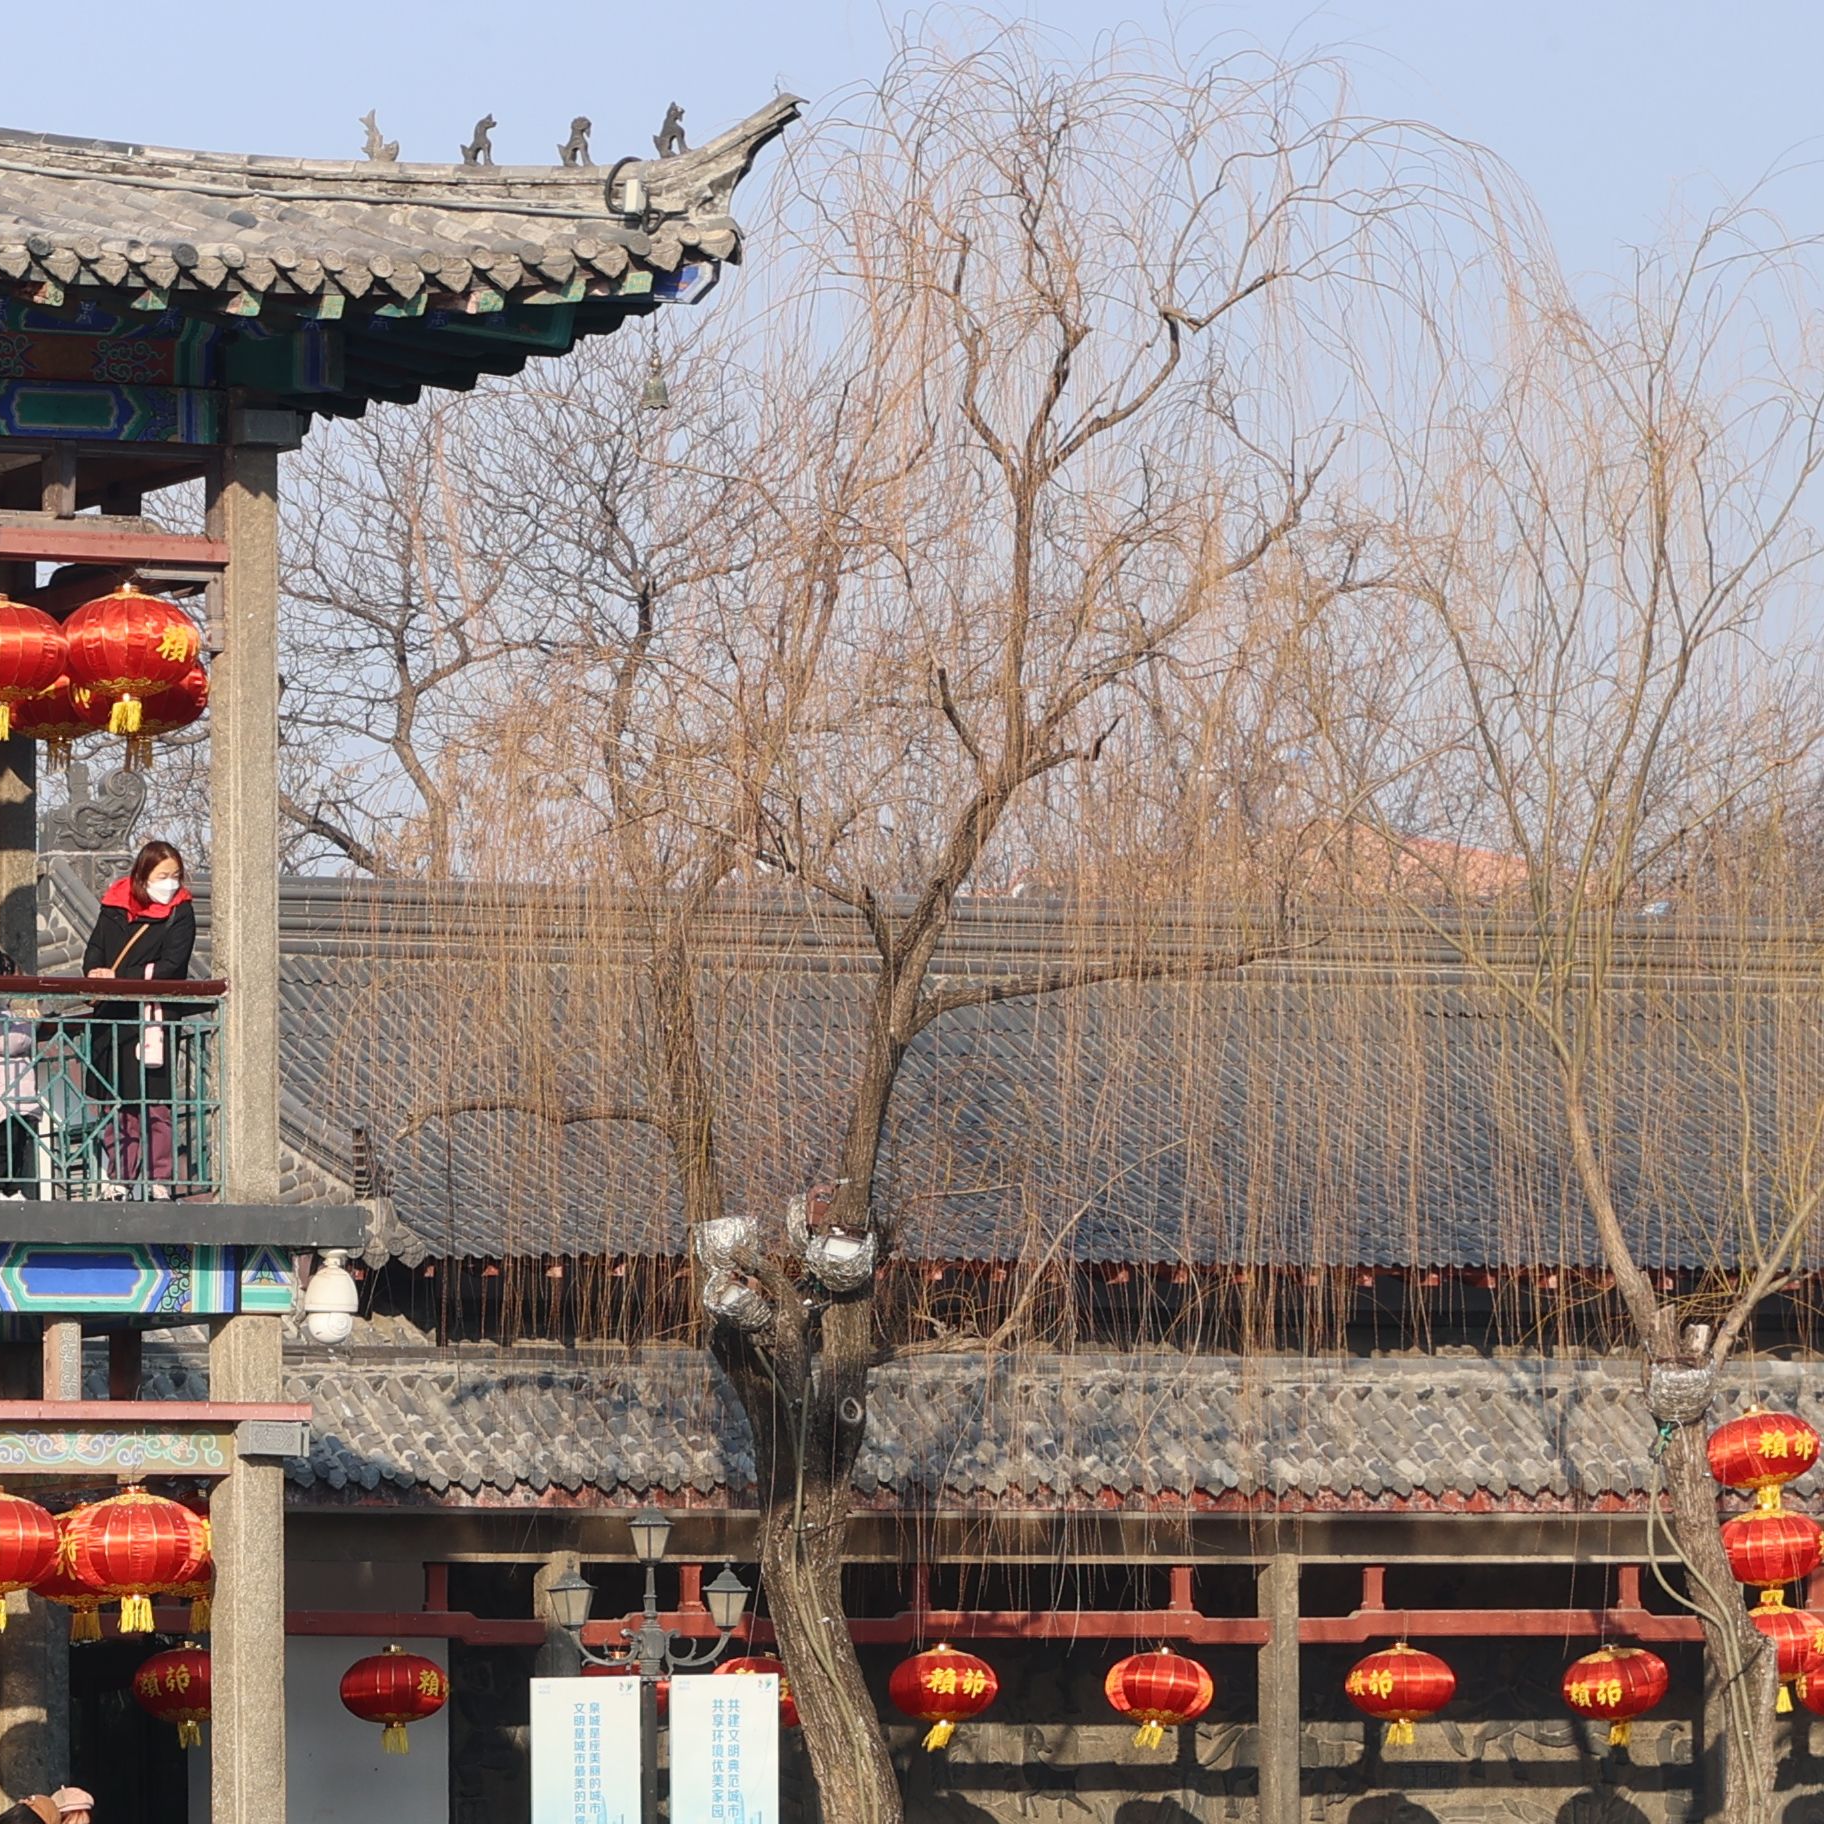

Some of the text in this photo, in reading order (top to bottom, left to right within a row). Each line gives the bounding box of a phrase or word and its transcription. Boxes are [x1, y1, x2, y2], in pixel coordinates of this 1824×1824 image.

[712, 1698, 724, 1819] 共享环境优美家园
[727, 1698, 740, 1819] 共建文明典范城市
